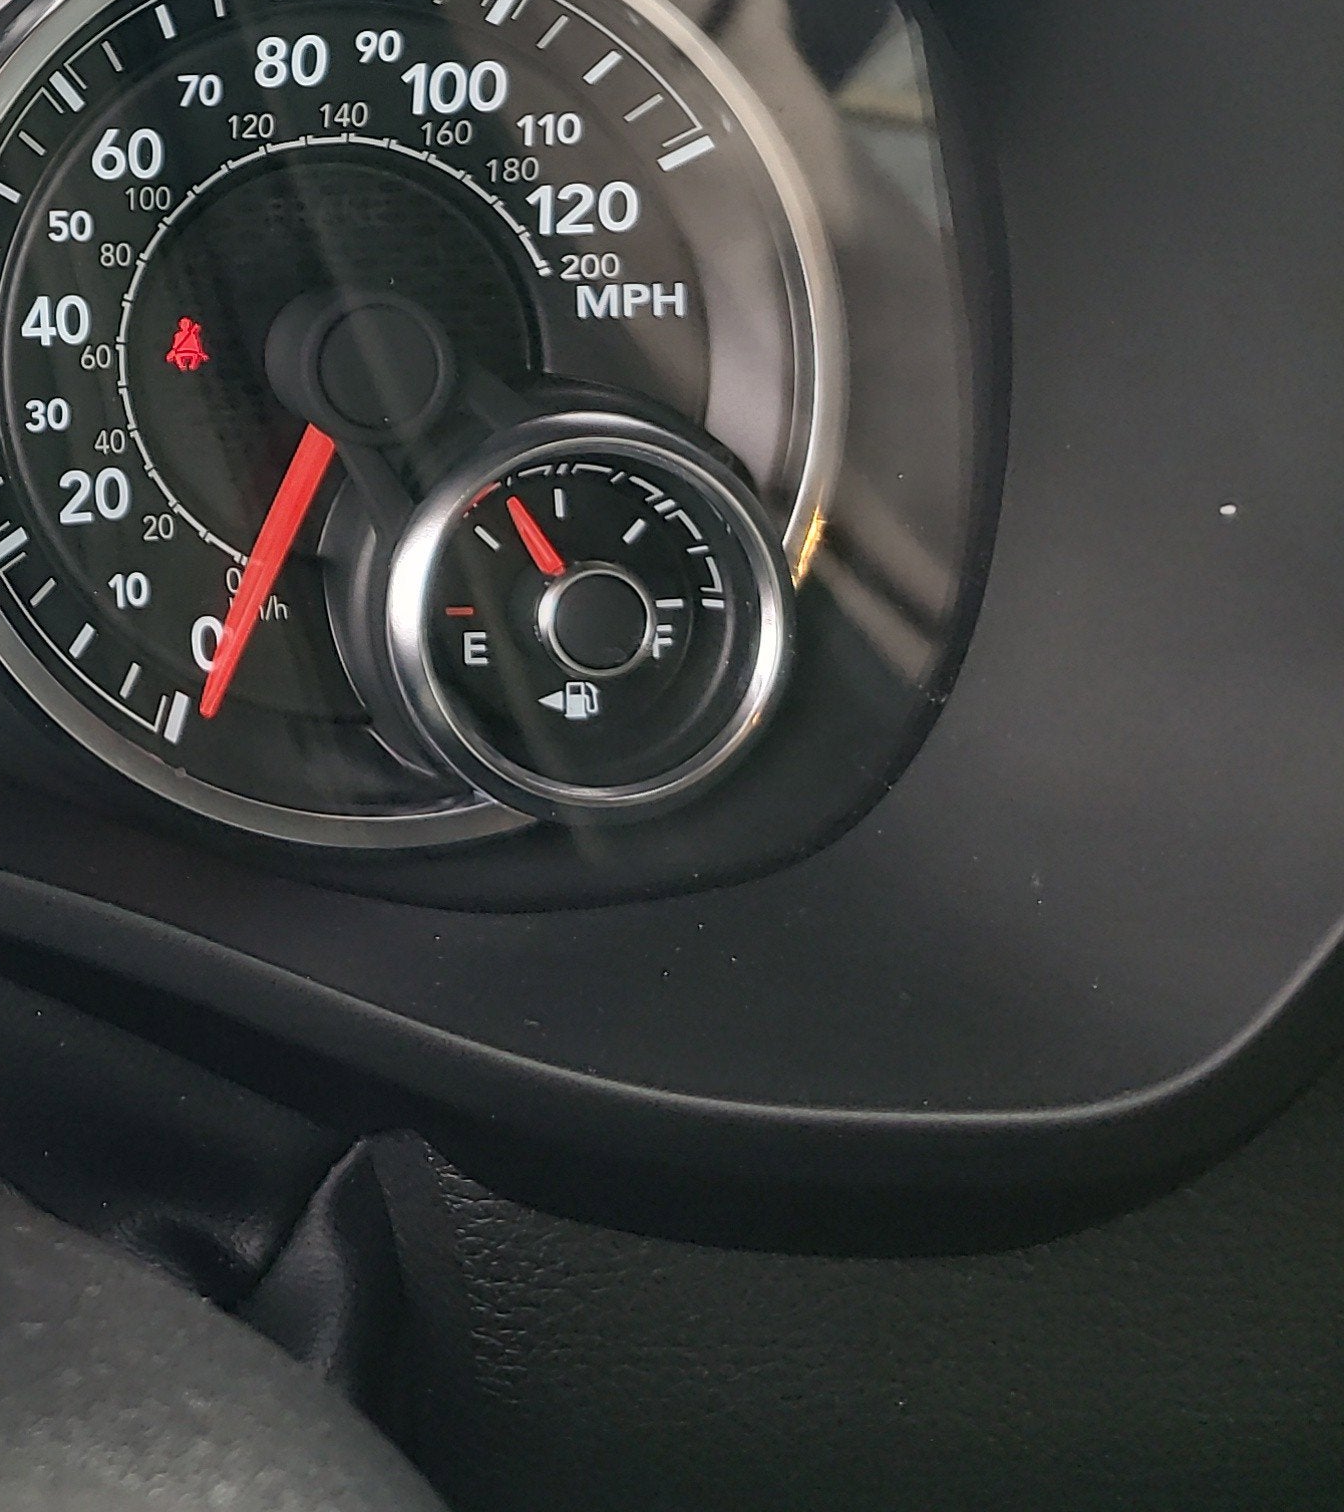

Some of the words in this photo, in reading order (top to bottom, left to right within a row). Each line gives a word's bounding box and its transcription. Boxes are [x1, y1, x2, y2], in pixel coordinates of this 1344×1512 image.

[255, 35, 327, 87] 80
[356, 30, 401, 63] 90
[178, 75, 221, 106] 70
[401, 61, 508, 115] 100
[229, 114, 274, 139] 120
[320, 102, 368, 128] 140
[517, 113, 582, 146] 110
[422, 119, 473, 147] 160
[92, 129, 162, 179] 60
[487, 157, 541, 182] 180
[126, 187, 170, 210] 100
[526, 182, 640, 235] 120
[49, 211, 92, 242] 50
[101, 243, 131, 267] 80
[561, 253, 620, 280] 200
[577, 283, 687, 318] MPH
[22, 295, 90, 346] 40
[81, 345, 111, 369] 60
[26, 398, 70, 432] 30
[95, 429, 125, 454] 40
[60, 468, 129, 524] 20
[143, 514, 175, 542] 20
[108, 572, 149, 609] 10
[226, 567, 243, 595] 0
[191, 615, 225, 673] 0
[464, 632, 489, 665] E
[653, 624, 673, 659] F
